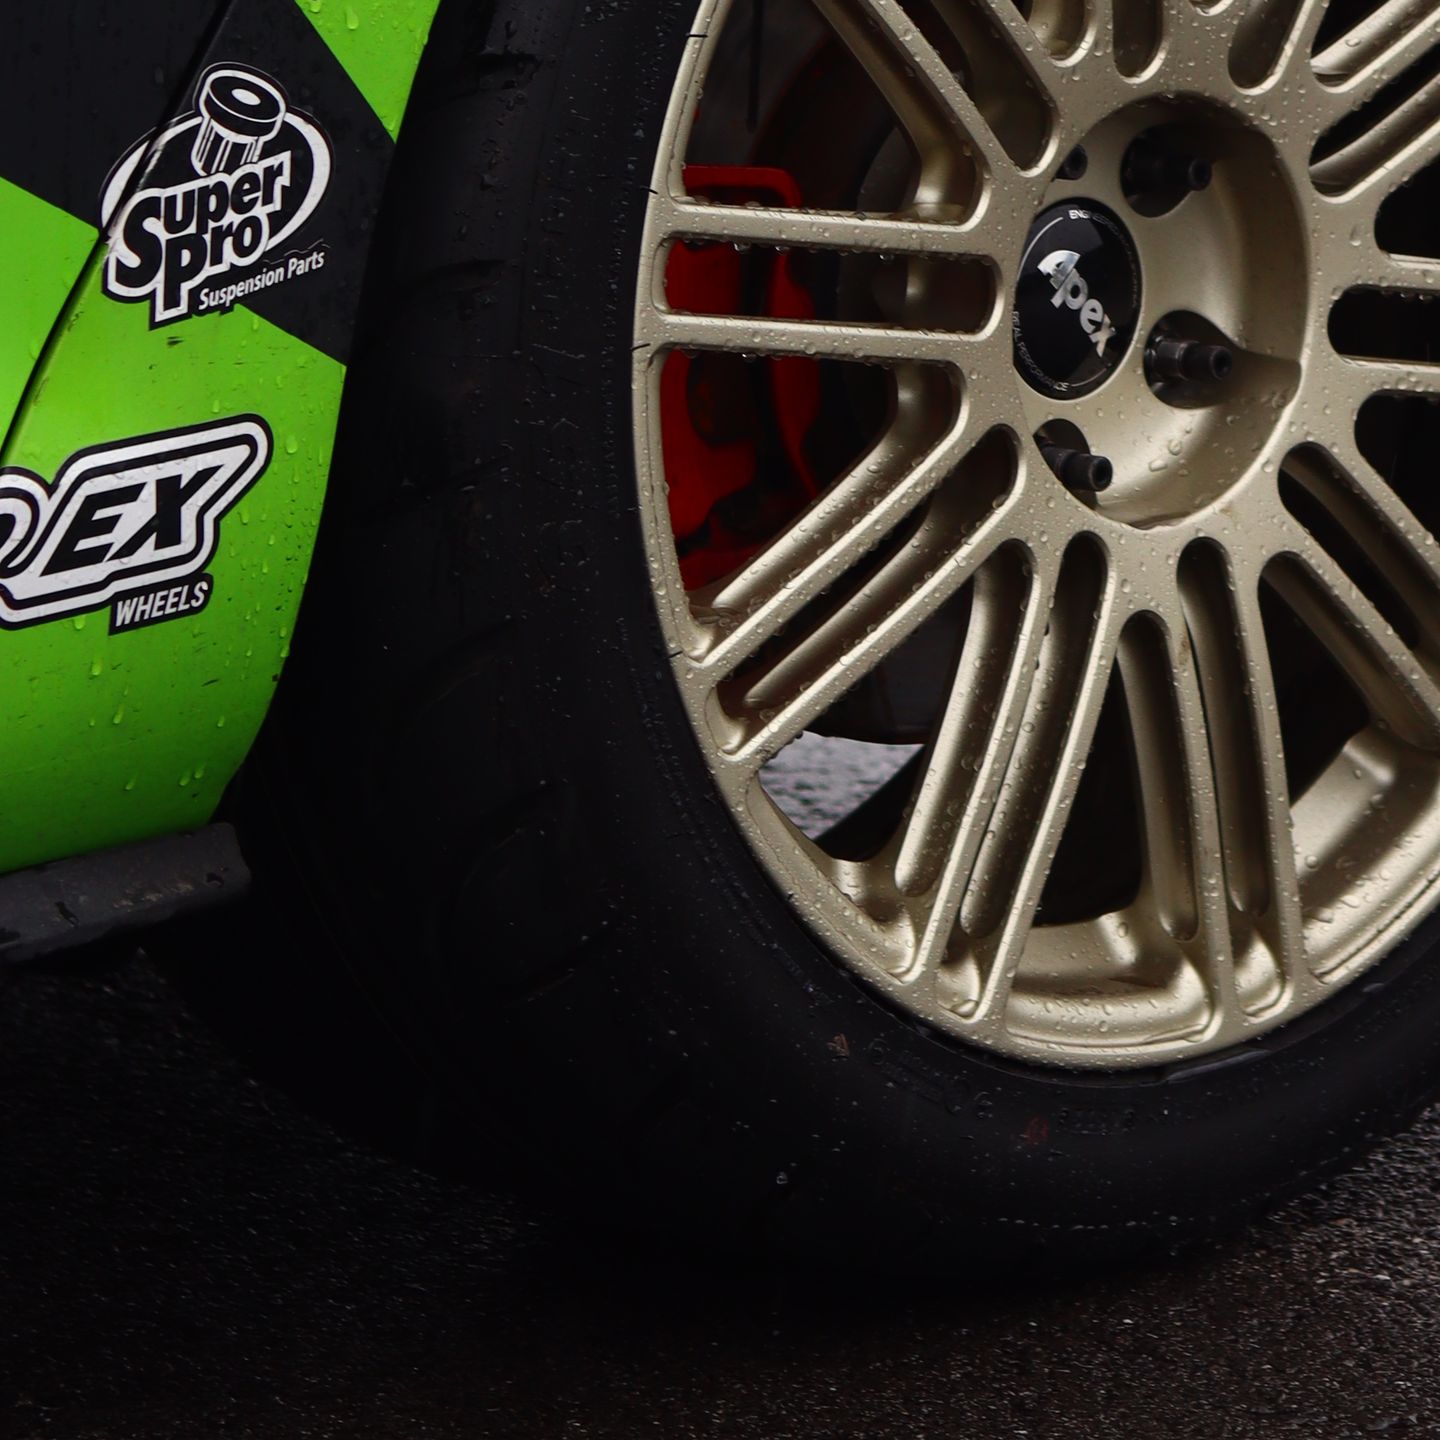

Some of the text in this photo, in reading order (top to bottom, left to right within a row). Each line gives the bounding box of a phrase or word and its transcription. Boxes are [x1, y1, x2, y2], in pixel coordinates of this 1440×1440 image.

[111, 156, 289, 293] Super
[159, 213, 267, 317] Pro
[198, 249, 325, 311] Suspension Parts
[114, 580, 209, 627] WHEELS
